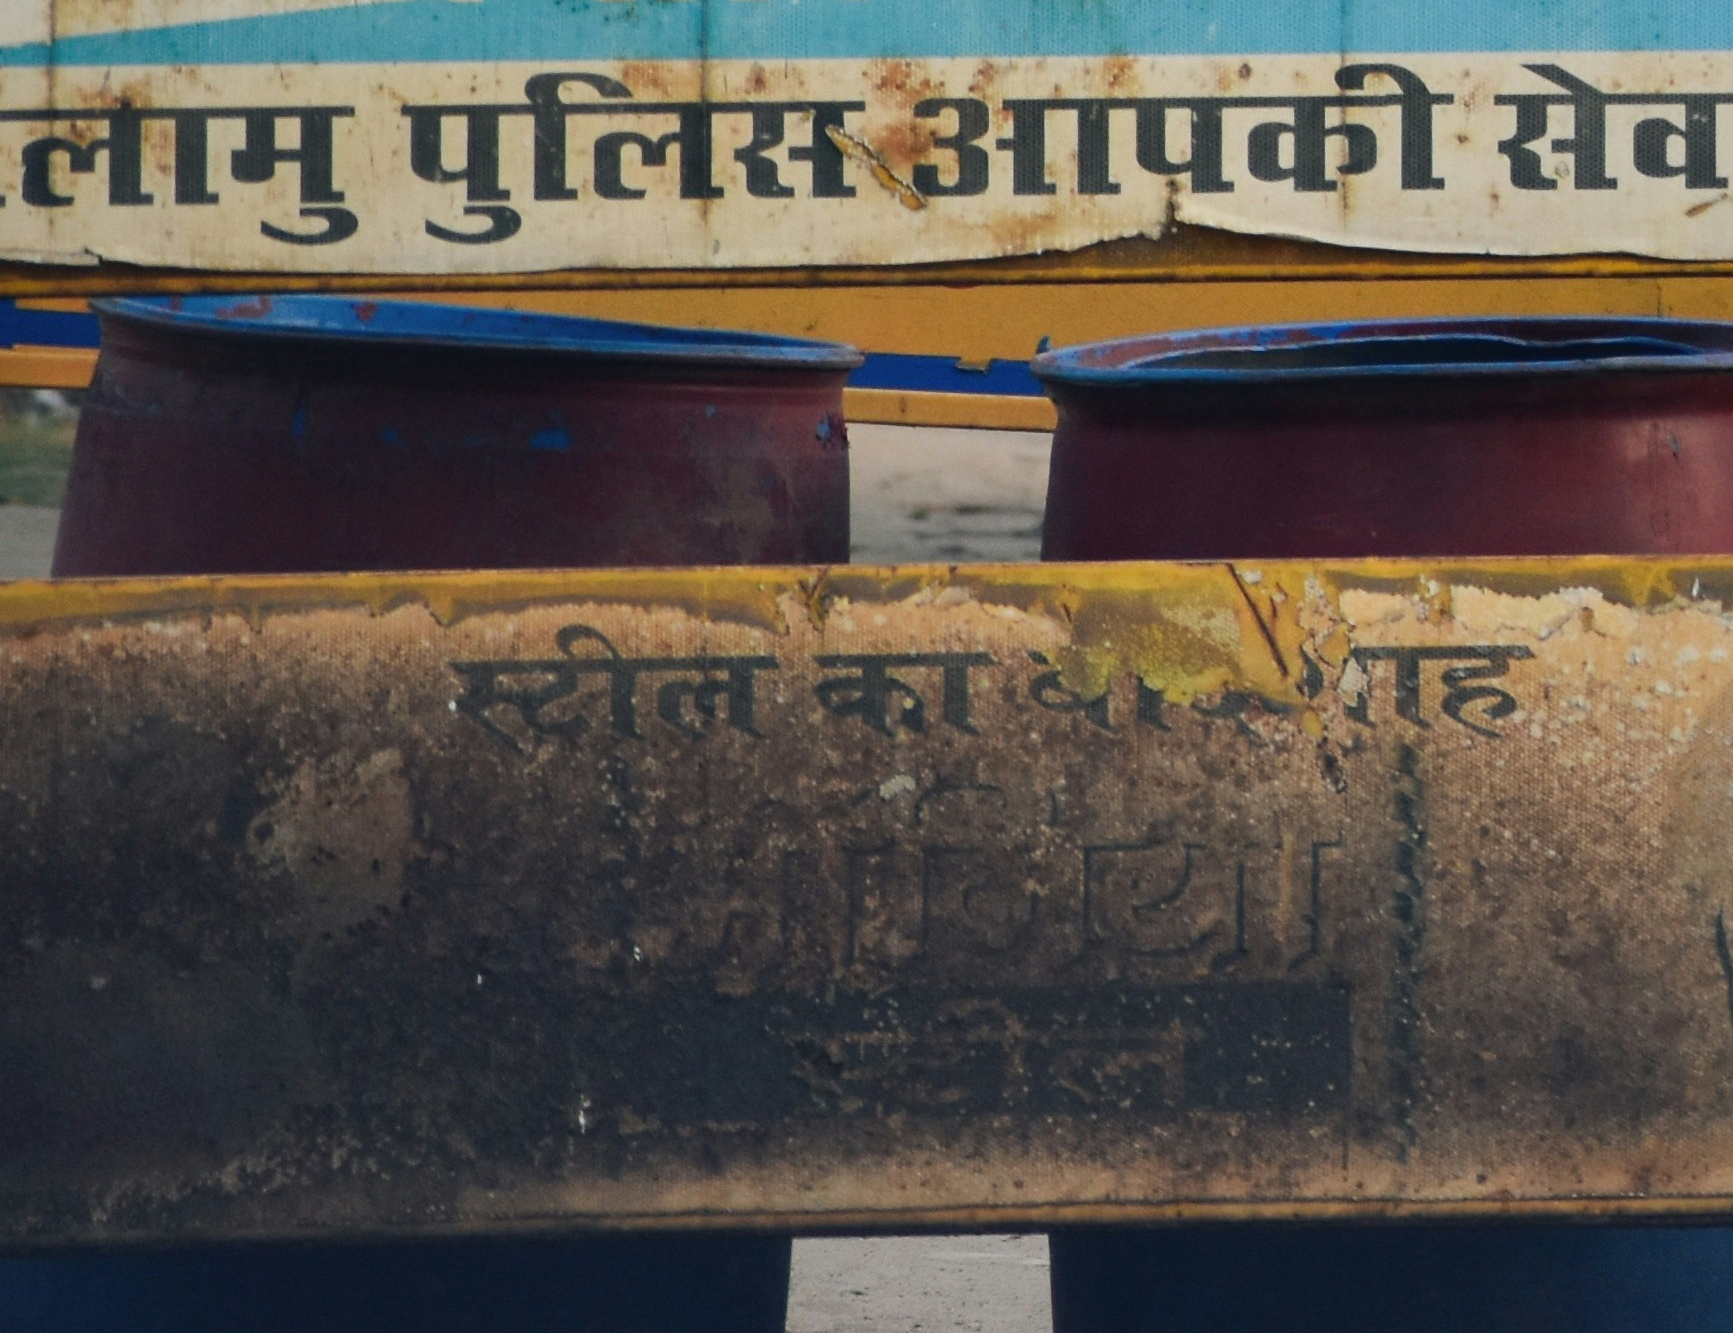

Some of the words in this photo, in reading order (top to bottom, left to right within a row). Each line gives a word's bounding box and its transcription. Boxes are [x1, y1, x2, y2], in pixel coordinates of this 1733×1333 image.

[0, 103, 362, 245] लामु
[400, 70, 868, 245] पुलिस
[912, 62, 1455, 199] आपकी
[447, 623, 782, 755] स्टील
[812, 649, 998, 737] का
